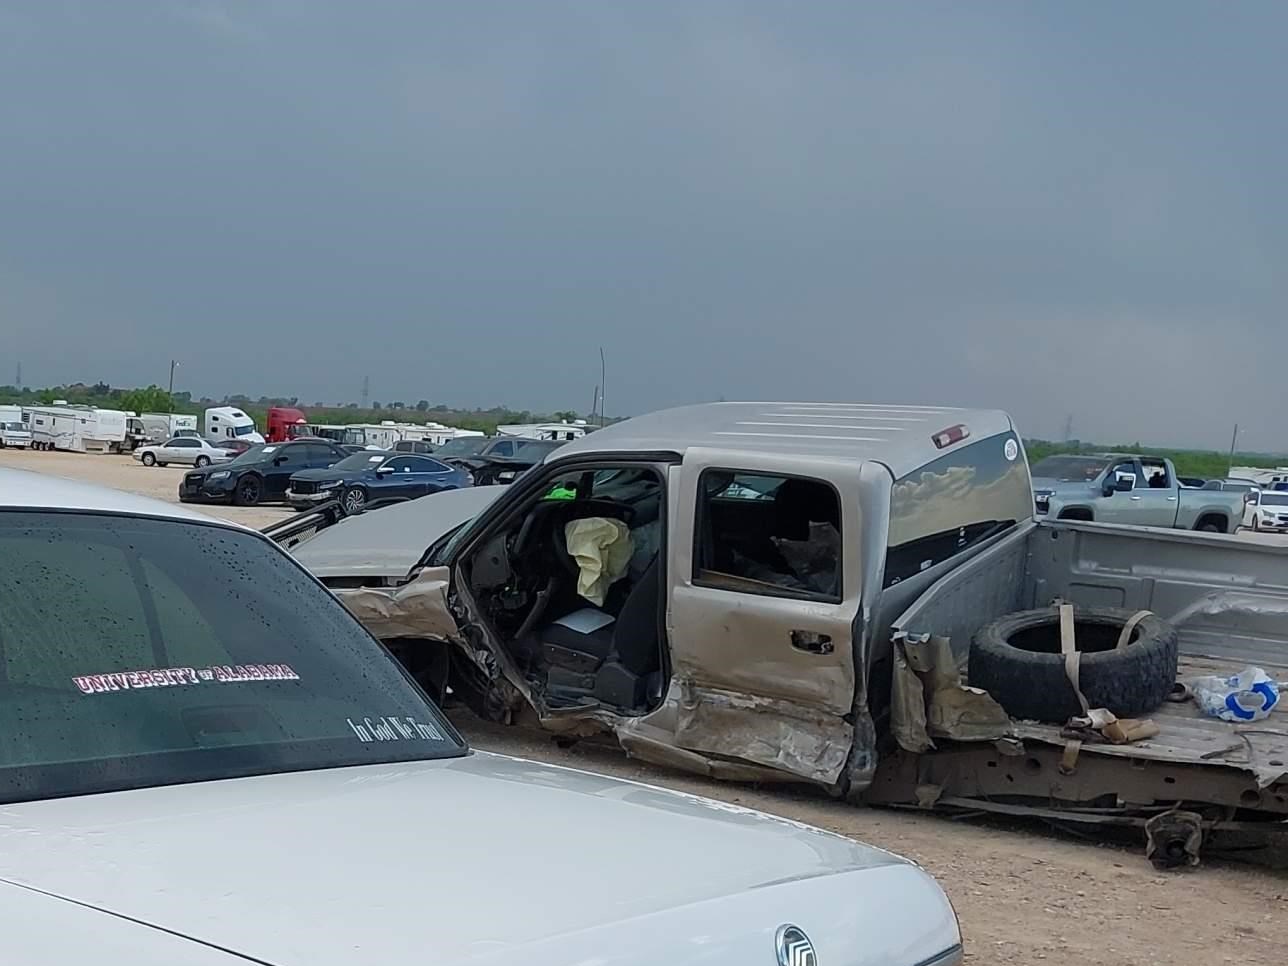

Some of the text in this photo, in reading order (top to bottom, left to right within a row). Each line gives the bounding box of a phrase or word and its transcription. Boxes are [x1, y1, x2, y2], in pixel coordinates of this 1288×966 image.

[72, 668, 200, 693] UNIVERSITY
[213, 664, 300, 681] ALABAMA
[347, 717, 444, 742] In God We Trust
